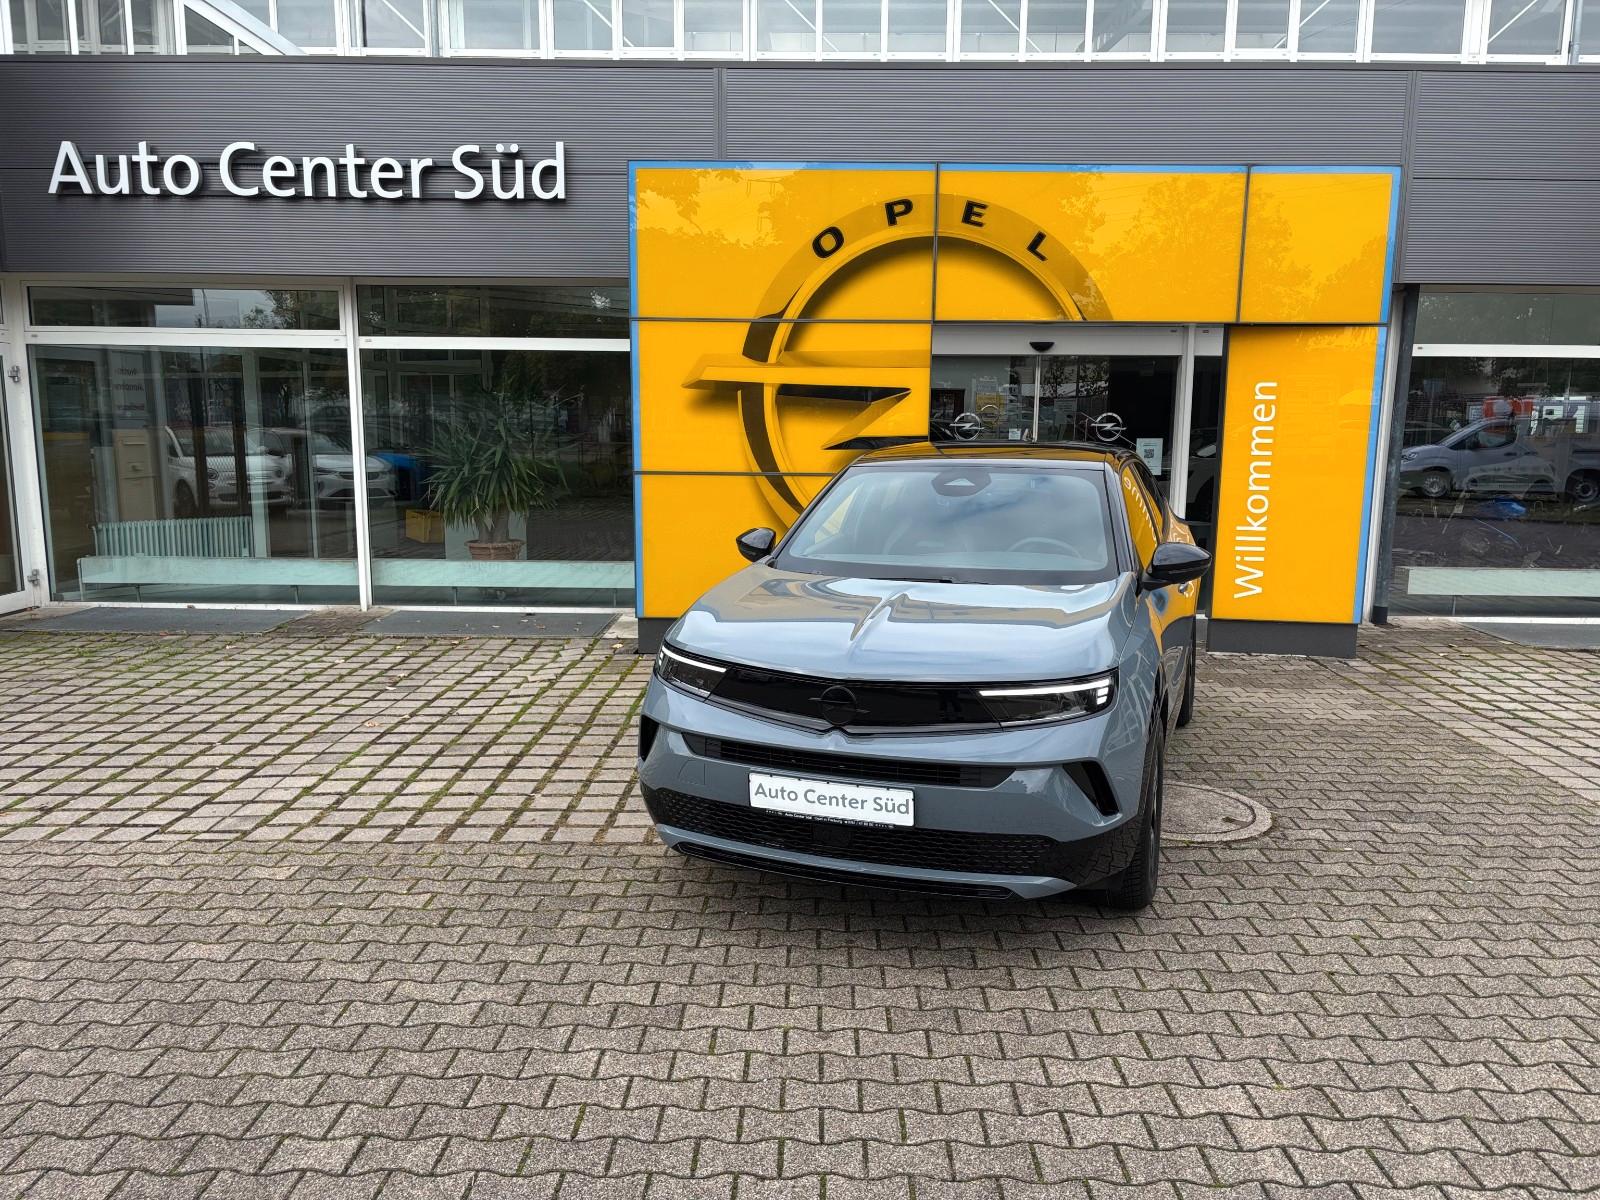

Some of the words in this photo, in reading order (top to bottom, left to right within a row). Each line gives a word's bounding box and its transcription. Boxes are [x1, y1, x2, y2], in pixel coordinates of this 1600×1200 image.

[48, 140, 201, 196] Auto
[219, 141, 434, 199] Center
[451, 141, 566, 200] Süd
[811, 197, 1049, 262] OPEL
[1233, 380, 1278, 599] Willkommen
[754, 782, 799, 802] Auto
[803, 788, 868, 810] Center
[872, 796, 910, 815] Süd
